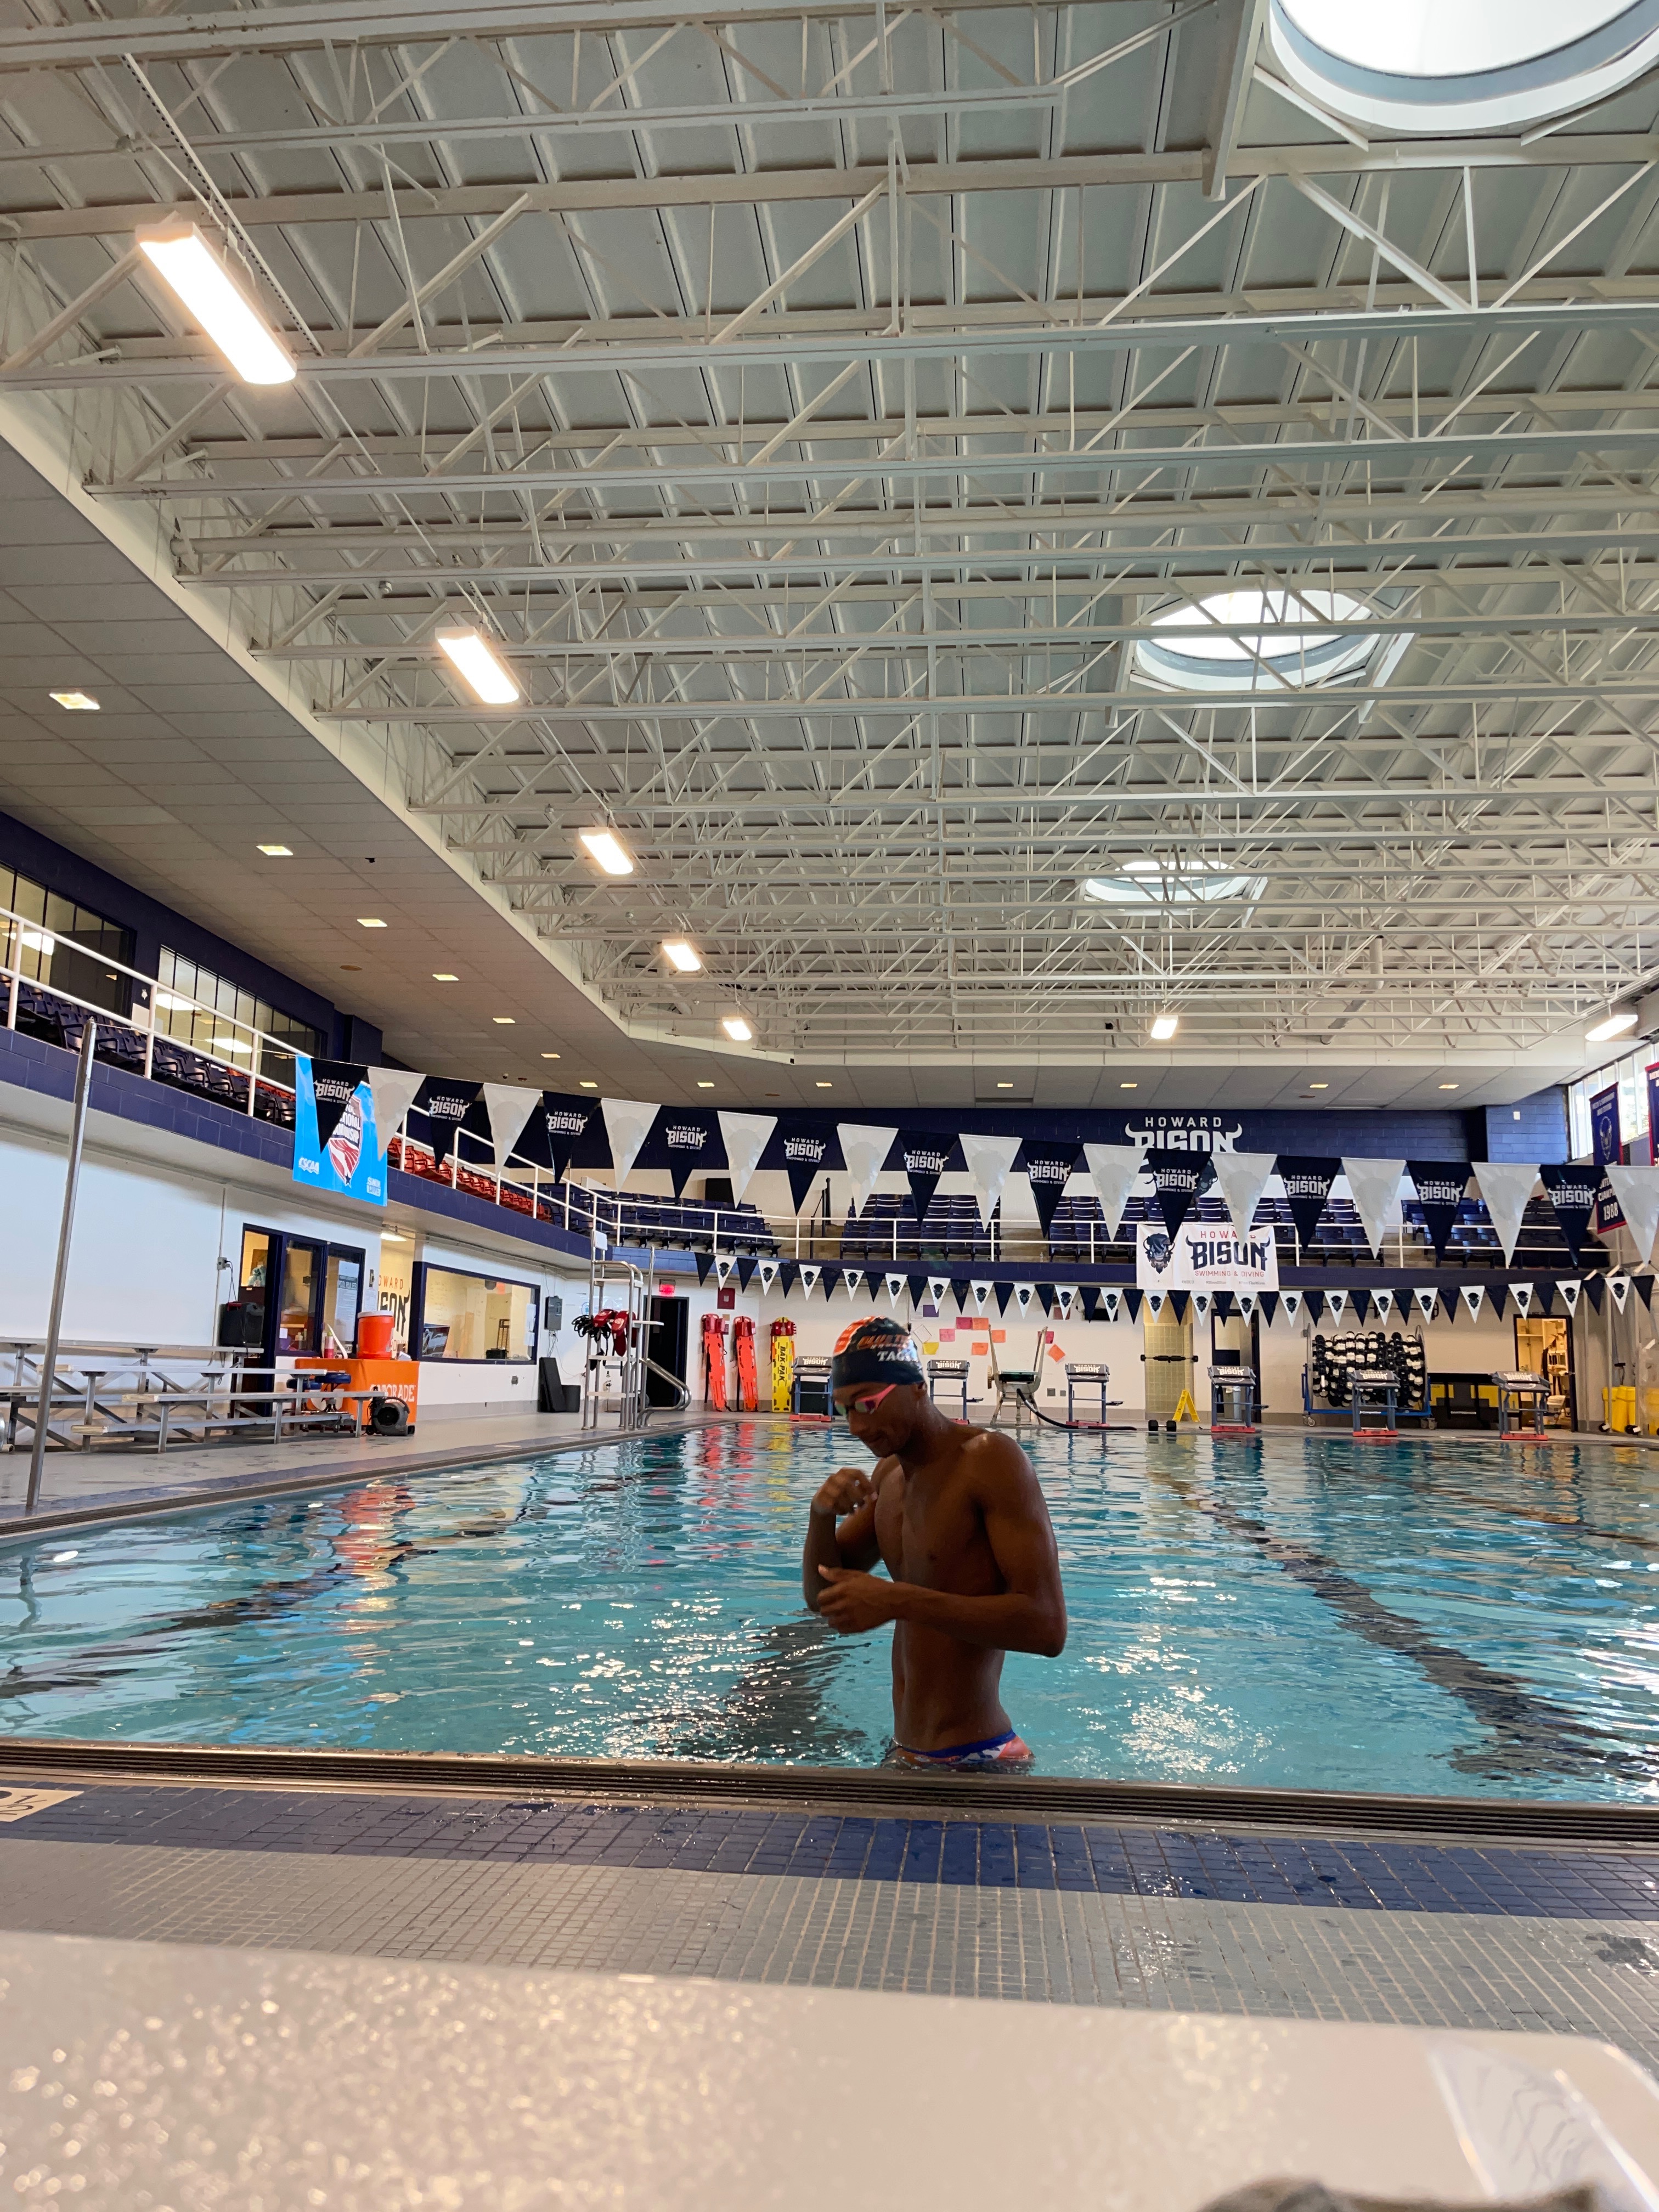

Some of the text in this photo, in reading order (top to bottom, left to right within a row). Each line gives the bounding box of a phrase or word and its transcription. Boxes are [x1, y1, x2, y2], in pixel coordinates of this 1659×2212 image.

[314, 1082, 355, 1102] BISON
[322, 1079, 349, 1087] HOWARD
[430, 1099, 470, 1119] BISON
[436, 1096, 464, 1104] HOWARD
[548, 1114, 588, 1133] BISON
[1145, 1116, 1222, 1127] HOWARD
[666, 1129, 707, 1148] BISON
[785, 1141, 826, 1160] BISON
[905, 1154, 949, 1172] BISON
[1028, 1163, 1071, 1182] BISON
[1154, 1172, 1199, 1190] BISON
[1285, 1179, 1330, 1197] BISON
[1418, 1184, 1463, 1203] BISON
[1548, 1189, 1596, 1206] BISON
[1200, 1231, 1256, 1239] HOWAD
[1187, 1237, 1270, 1271] BISON
[378, 1275, 403, 1290] OWARD
